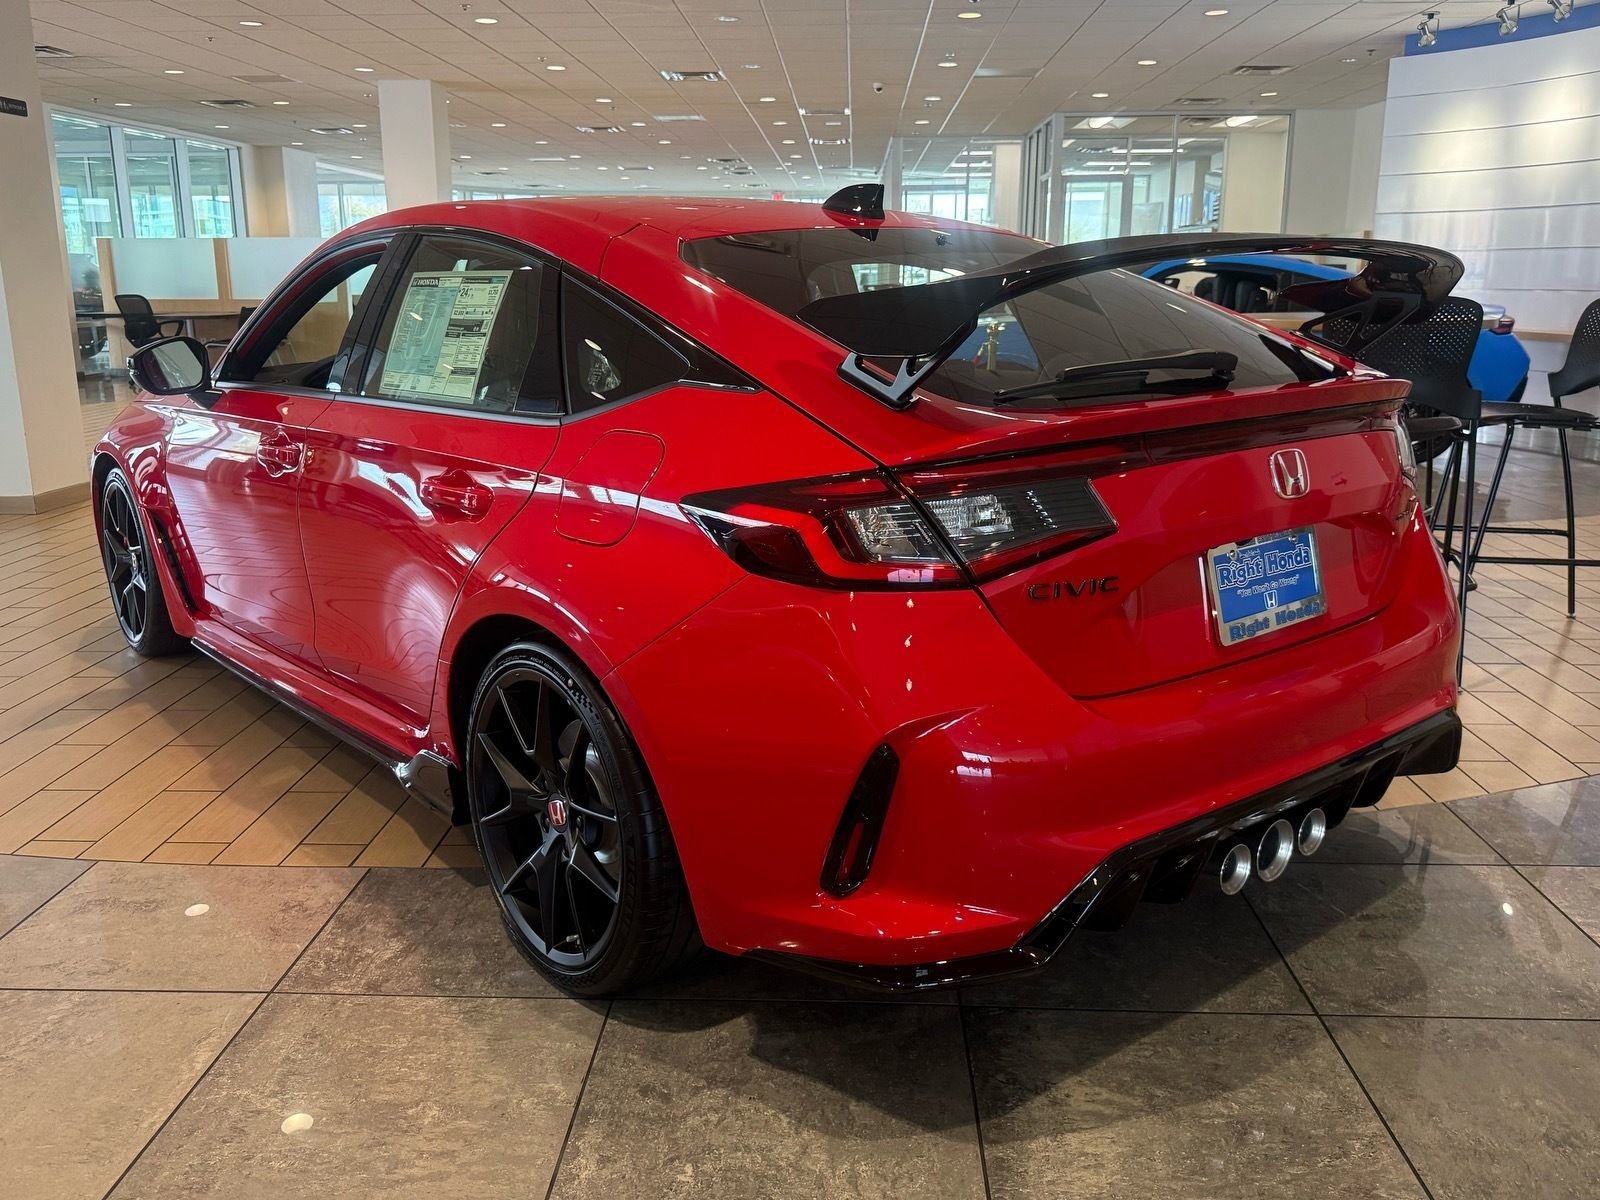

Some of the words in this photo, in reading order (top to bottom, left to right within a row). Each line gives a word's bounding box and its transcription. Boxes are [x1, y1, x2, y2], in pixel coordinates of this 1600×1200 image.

[417, 278, 438, 286] HONDA
[1216, 558, 1263, 589] Right
[1264, 545, 1312, 576] Honda
[1028, 576, 1119, 600] CIVIC
[1229, 617, 1270, 641] Right
[1275, 600, 1320, 625] Honda
